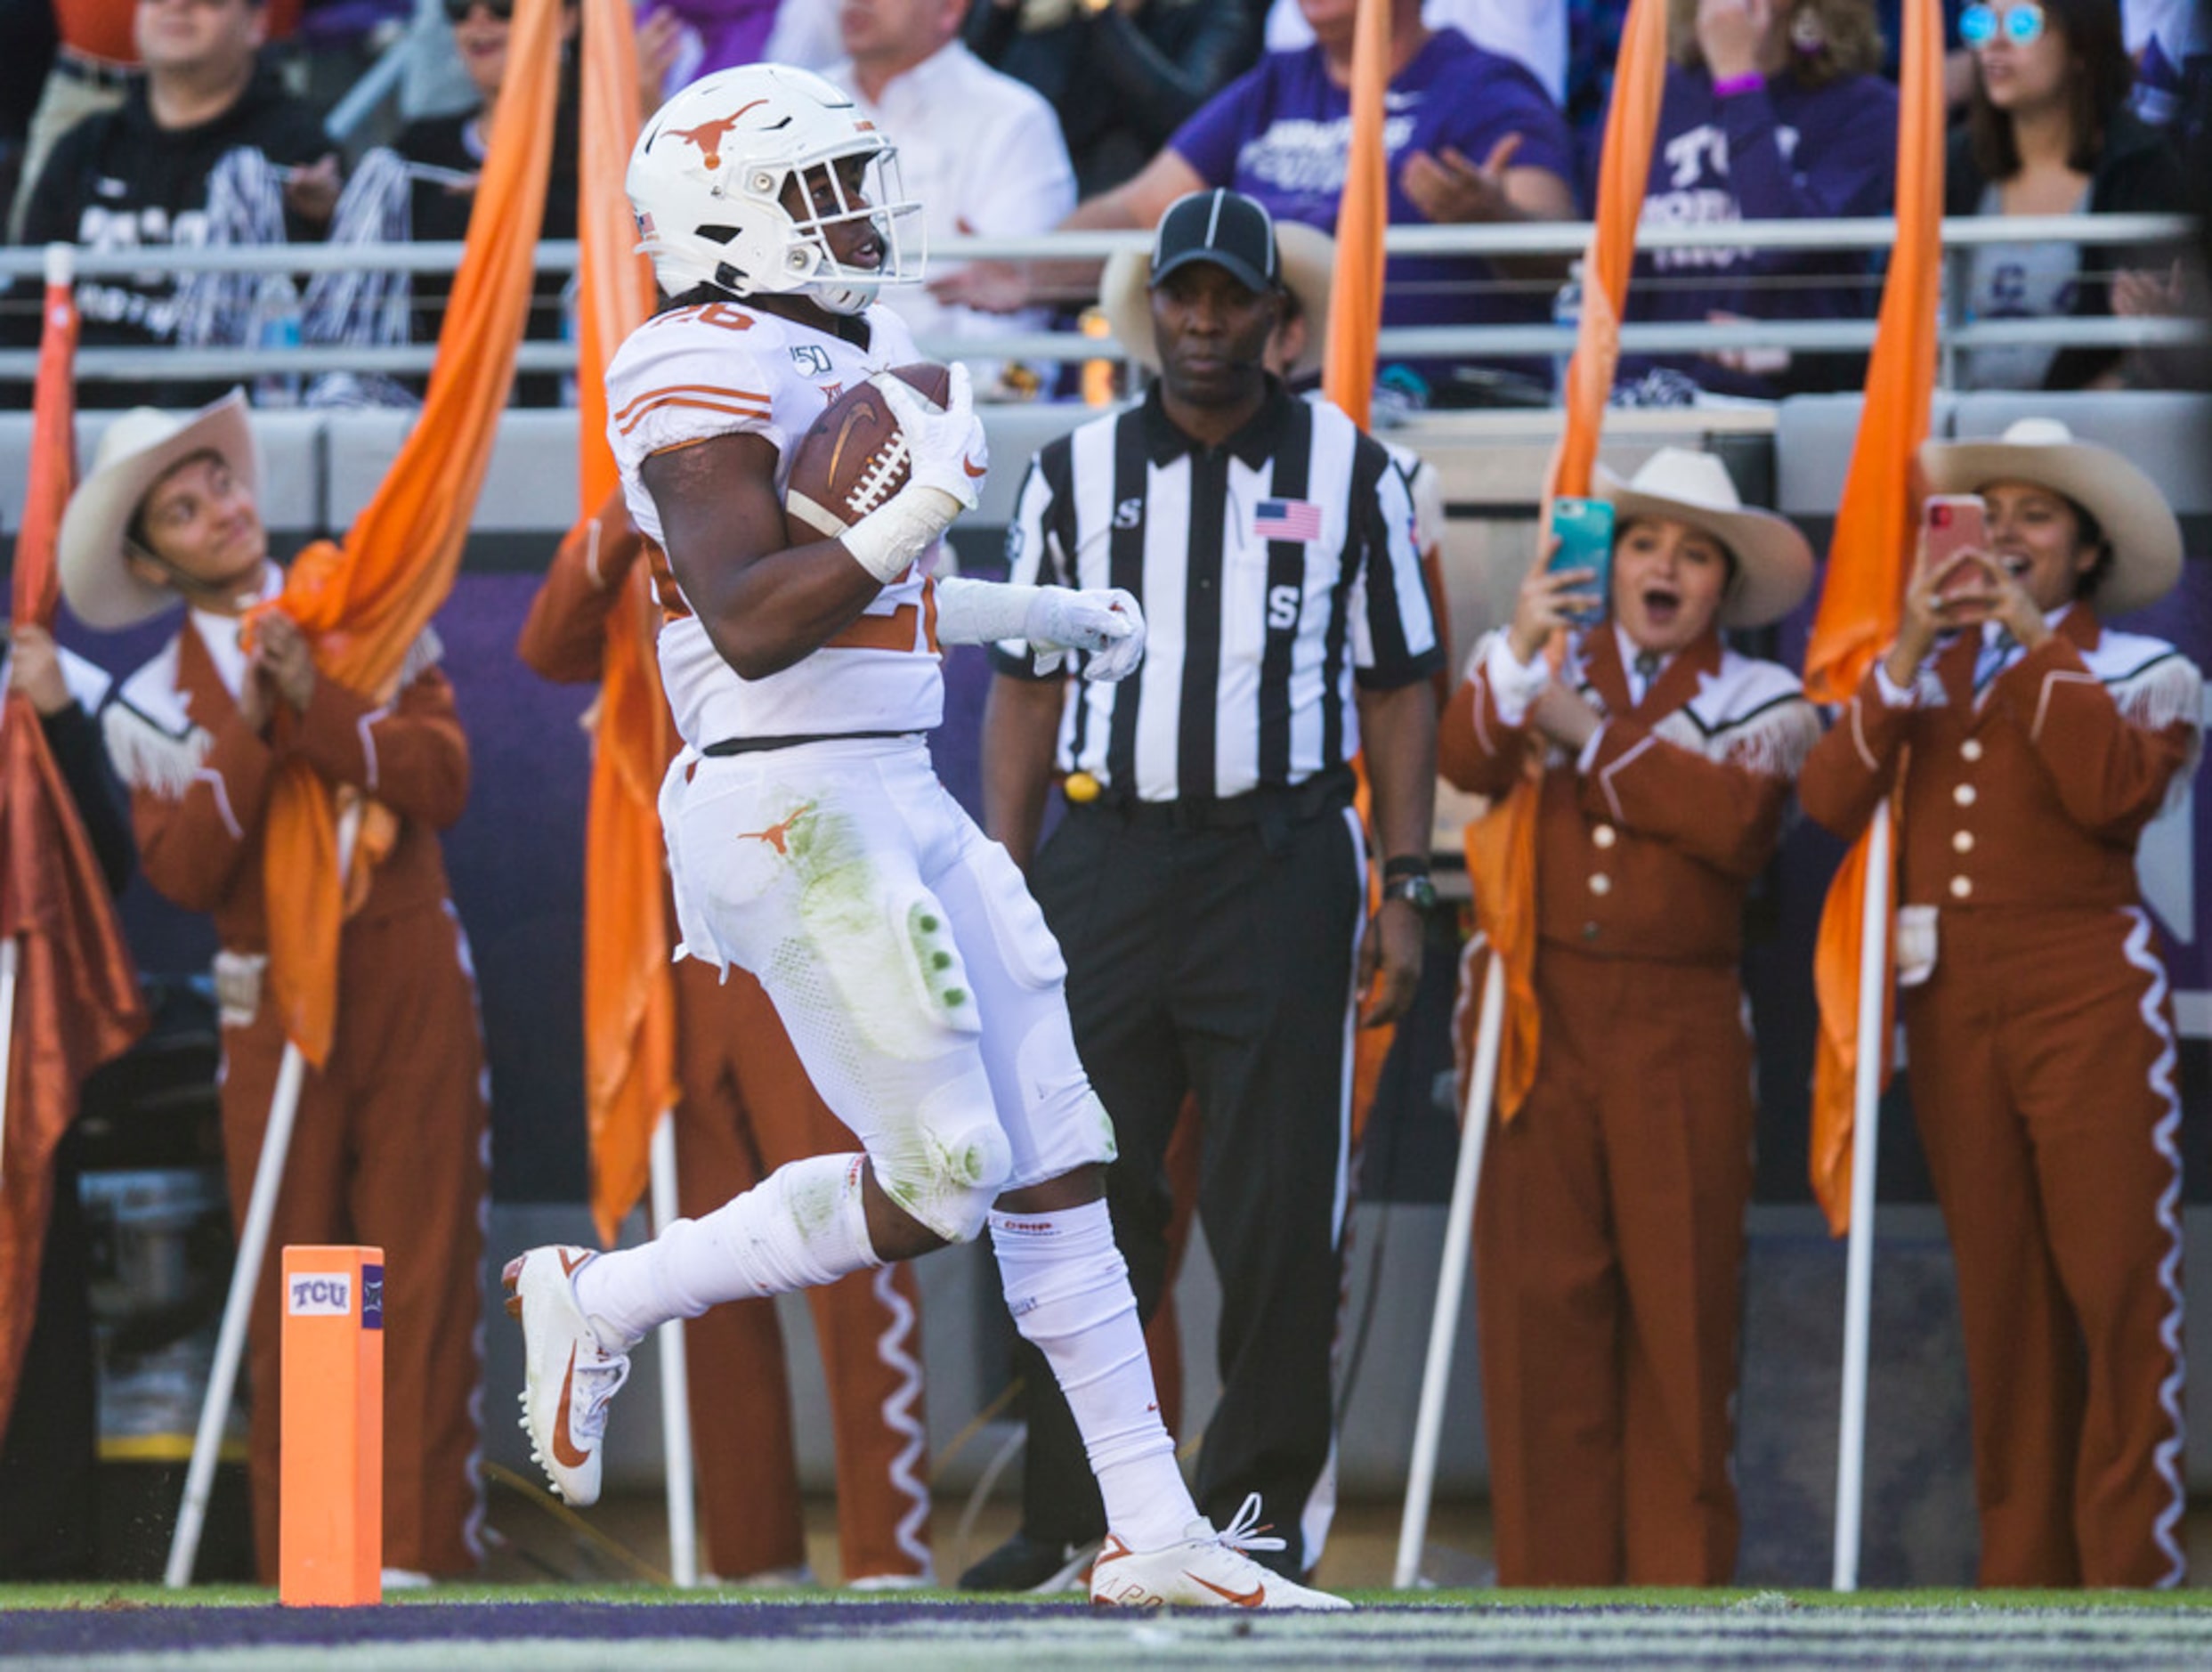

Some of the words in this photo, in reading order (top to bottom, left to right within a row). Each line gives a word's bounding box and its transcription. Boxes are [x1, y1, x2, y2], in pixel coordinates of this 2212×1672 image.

[1114, 497, 1142, 530] S
[1268, 583, 1300, 629] S
[293, 1279, 347, 1310] TCU
